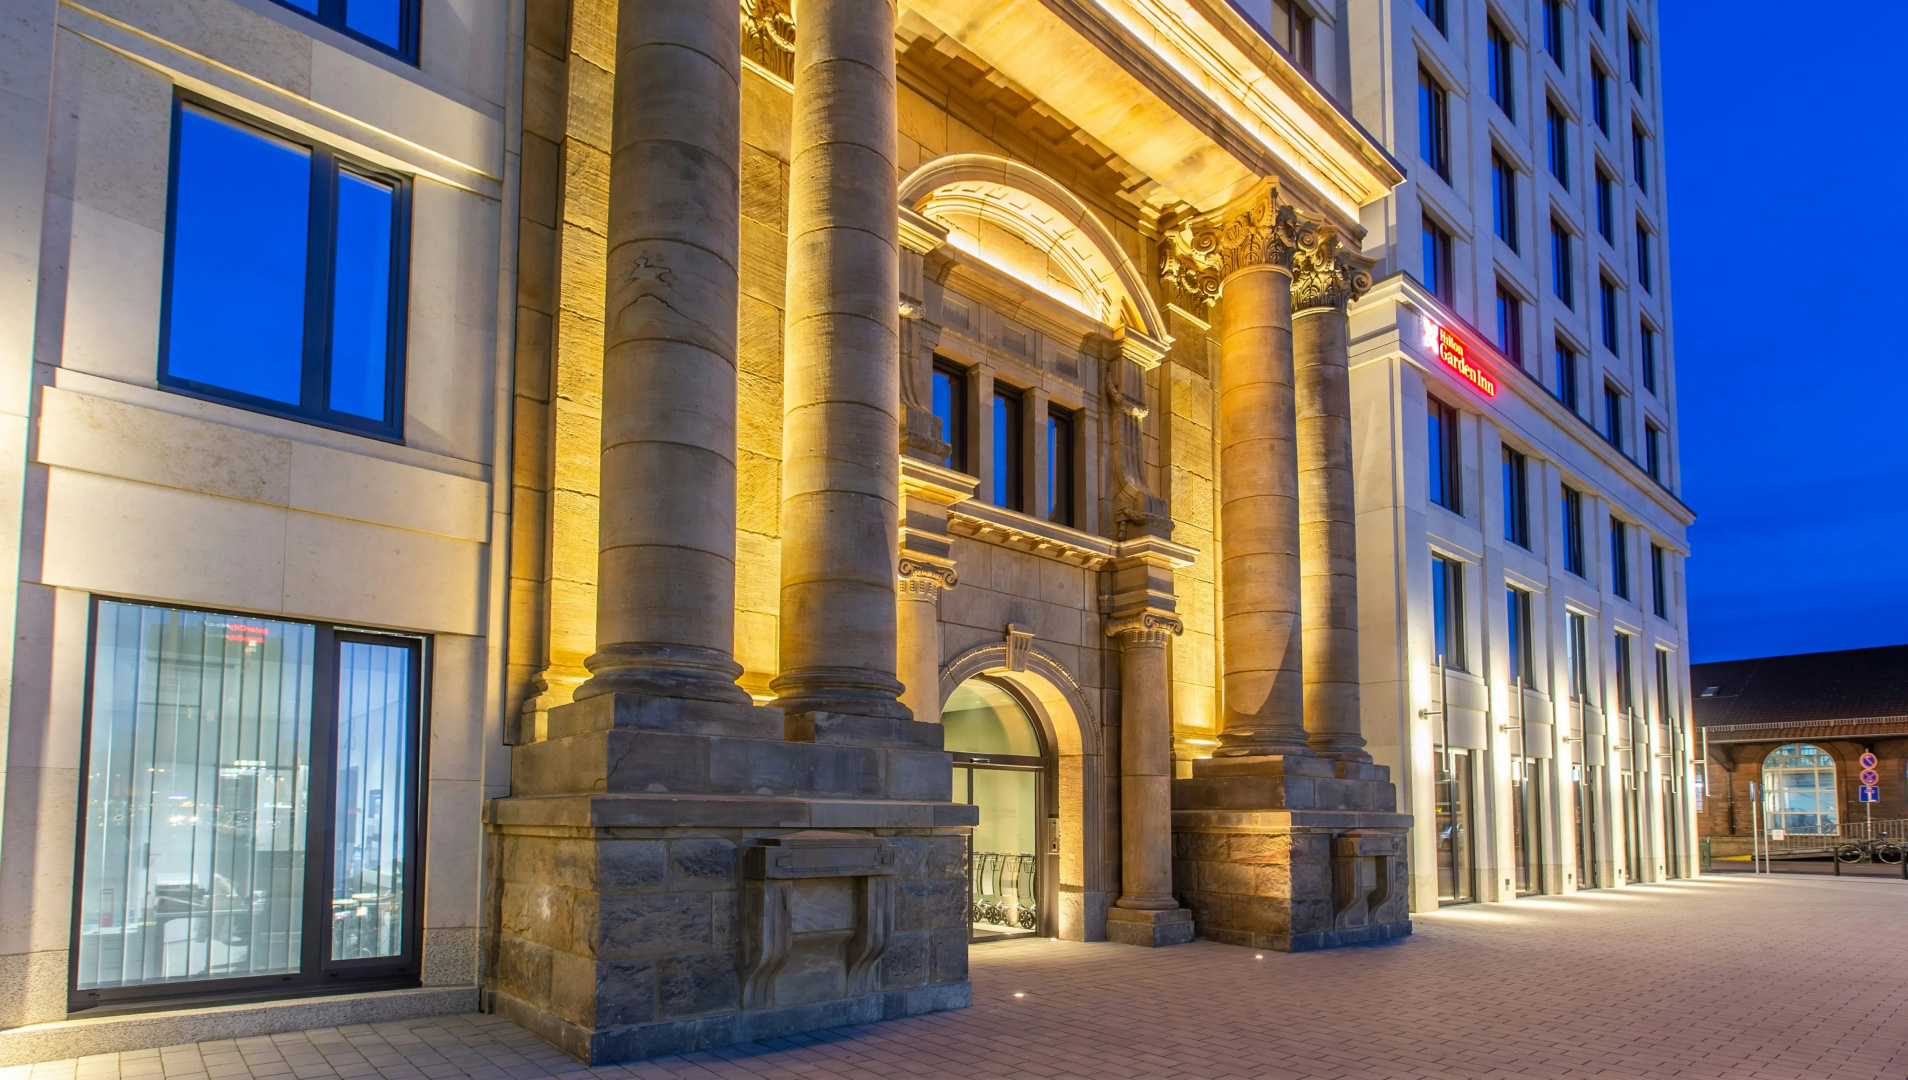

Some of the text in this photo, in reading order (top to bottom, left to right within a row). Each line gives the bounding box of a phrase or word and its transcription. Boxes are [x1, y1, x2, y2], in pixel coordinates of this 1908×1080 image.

[1440, 328, 1463, 356] Hilton
[1440, 342, 1495, 396] Garden Inn
